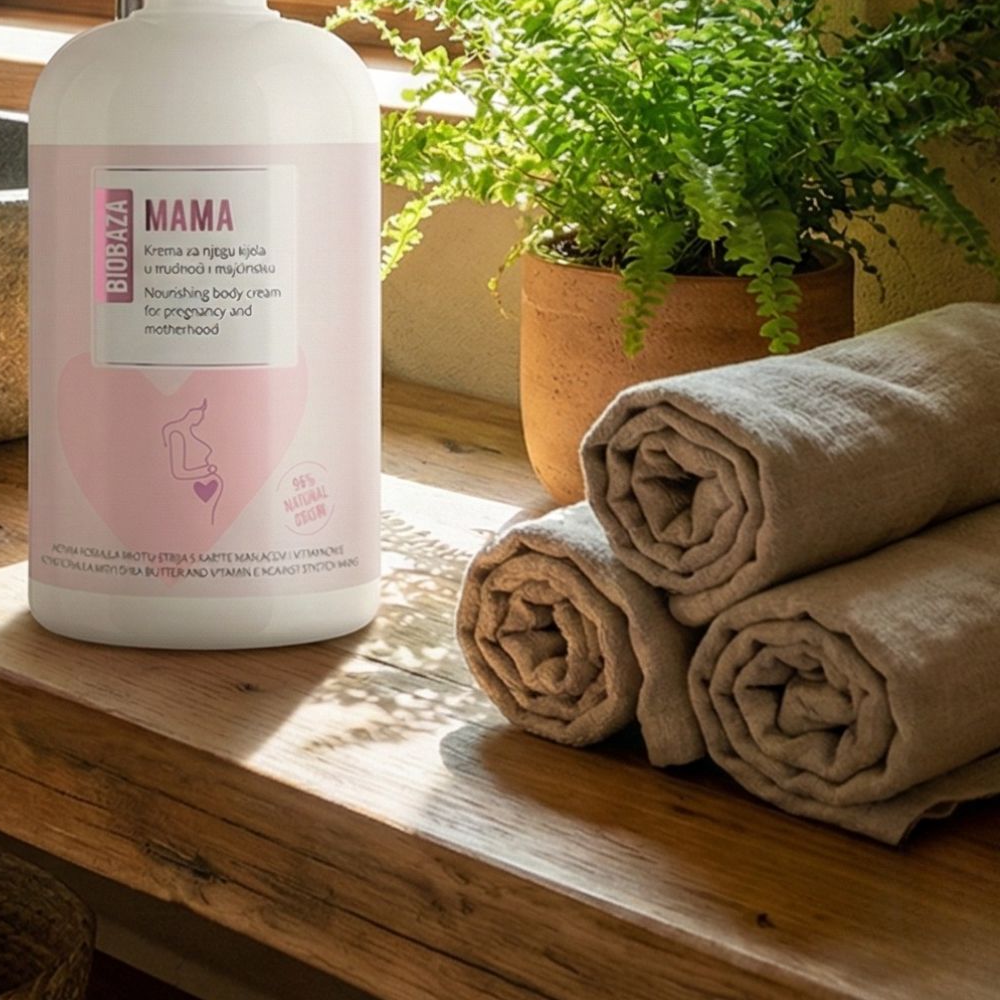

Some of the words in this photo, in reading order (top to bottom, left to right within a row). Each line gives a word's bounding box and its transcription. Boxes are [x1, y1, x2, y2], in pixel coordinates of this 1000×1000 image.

[145, 198, 235, 232] MAMA
[105, 199, 129, 294] BIOBAZA
[144, 244, 183, 257] Krema
[186, 246, 200, 257] za
[144, 264, 152, 274] u
[144, 285, 210, 302] Nourishing
[212, 286, 243, 301] body
[246, 288, 282, 299] cream
[144, 305, 161, 317] for
[164, 306, 227, 321] pregnancy
[229, 305, 253, 317] and
[144, 323, 220, 336] motherhood
